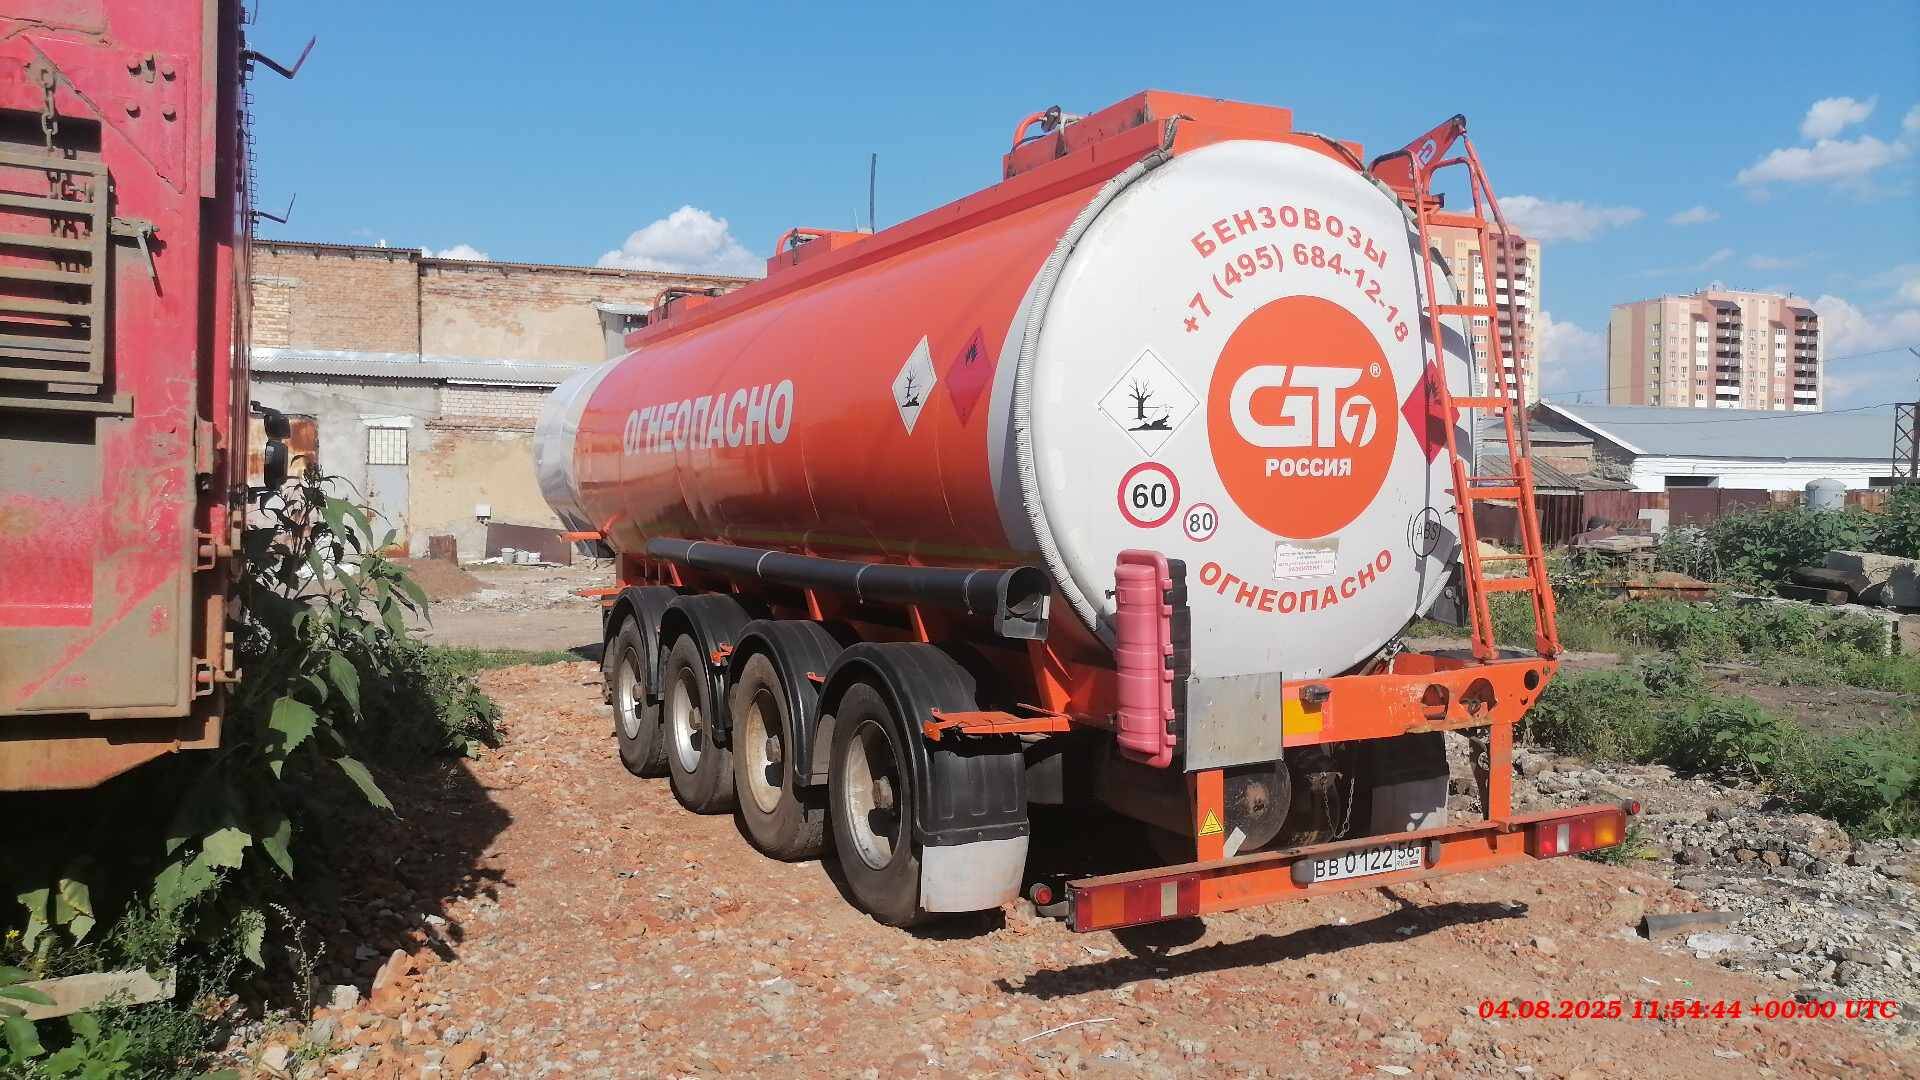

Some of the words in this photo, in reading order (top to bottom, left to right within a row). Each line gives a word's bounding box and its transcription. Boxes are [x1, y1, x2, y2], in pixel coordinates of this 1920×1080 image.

[1190, 205, 1388, 270] БЕНЗОВОЗЫ
[1183, 292, 1212, 333] +7
[1212, 243, 1284, 299] (495)
[1292, 243, 1409, 342] 684-12-18
[623, 379, 794, 457] ОГНЕОПАСНО
[1264, 457, 1352, 477] РОССИЯ
[1131, 483, 1167, 509] 60
[1189, 512, 1213, 533] 80
[1199, 549, 1392, 614] ОГНЕОПАСНО
[1345, 846, 1393, 874] 0122
